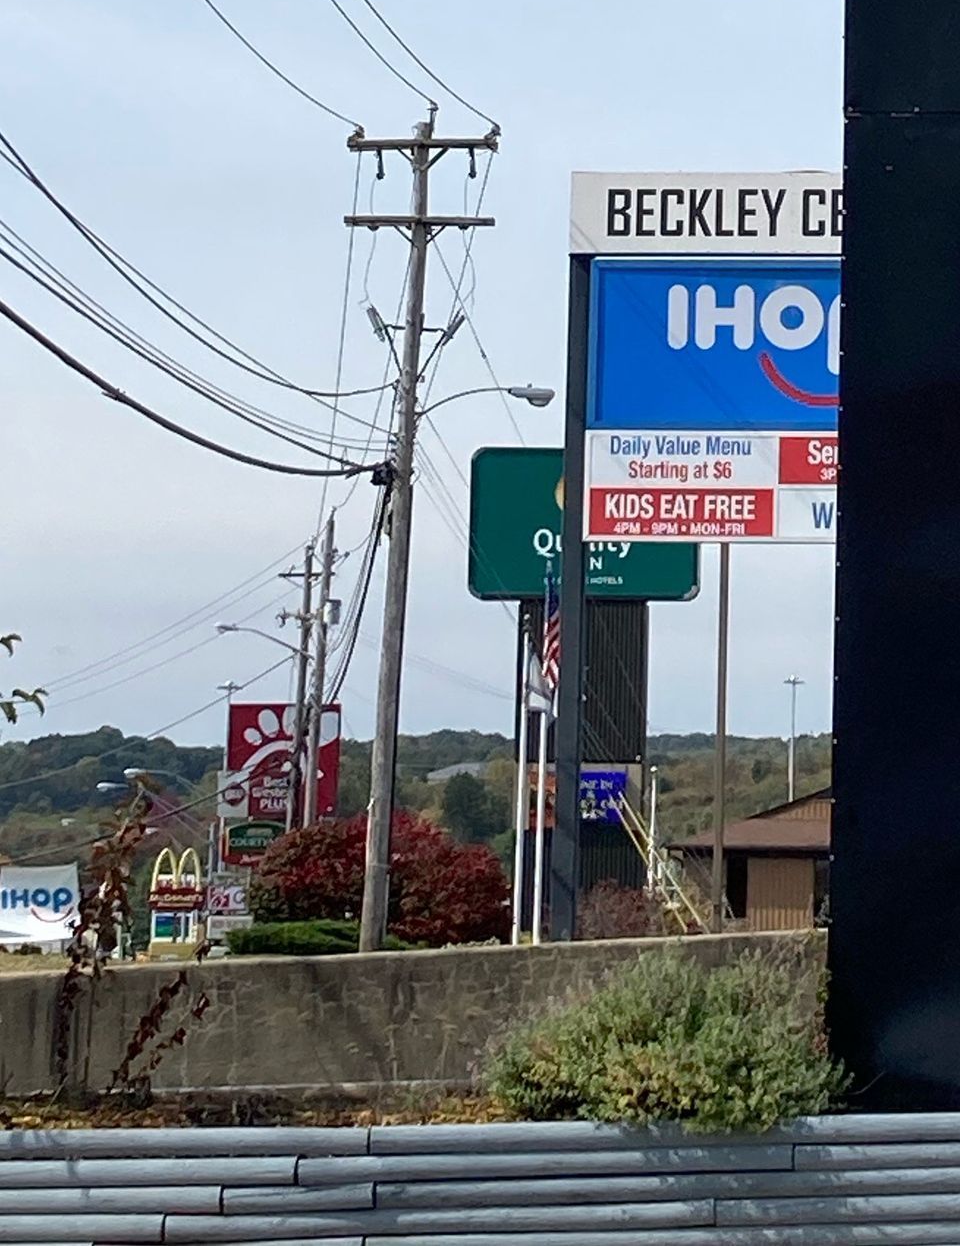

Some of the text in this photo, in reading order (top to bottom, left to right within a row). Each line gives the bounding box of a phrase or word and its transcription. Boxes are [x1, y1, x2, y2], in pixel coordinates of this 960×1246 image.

[606, 188, 787, 237] BECKLEY
[667, 284, 840, 375] IHO
[609, 435, 752, 458] Daily Value Menu
[628, 460, 733, 482] Starting at $6
[605, 493, 755, 520] KIDS EAT FREE
[613, 522, 641, 535] 4PM
[690, 522, 745, 535] MON-FRI
[1, 887, 74, 913] IHOP
